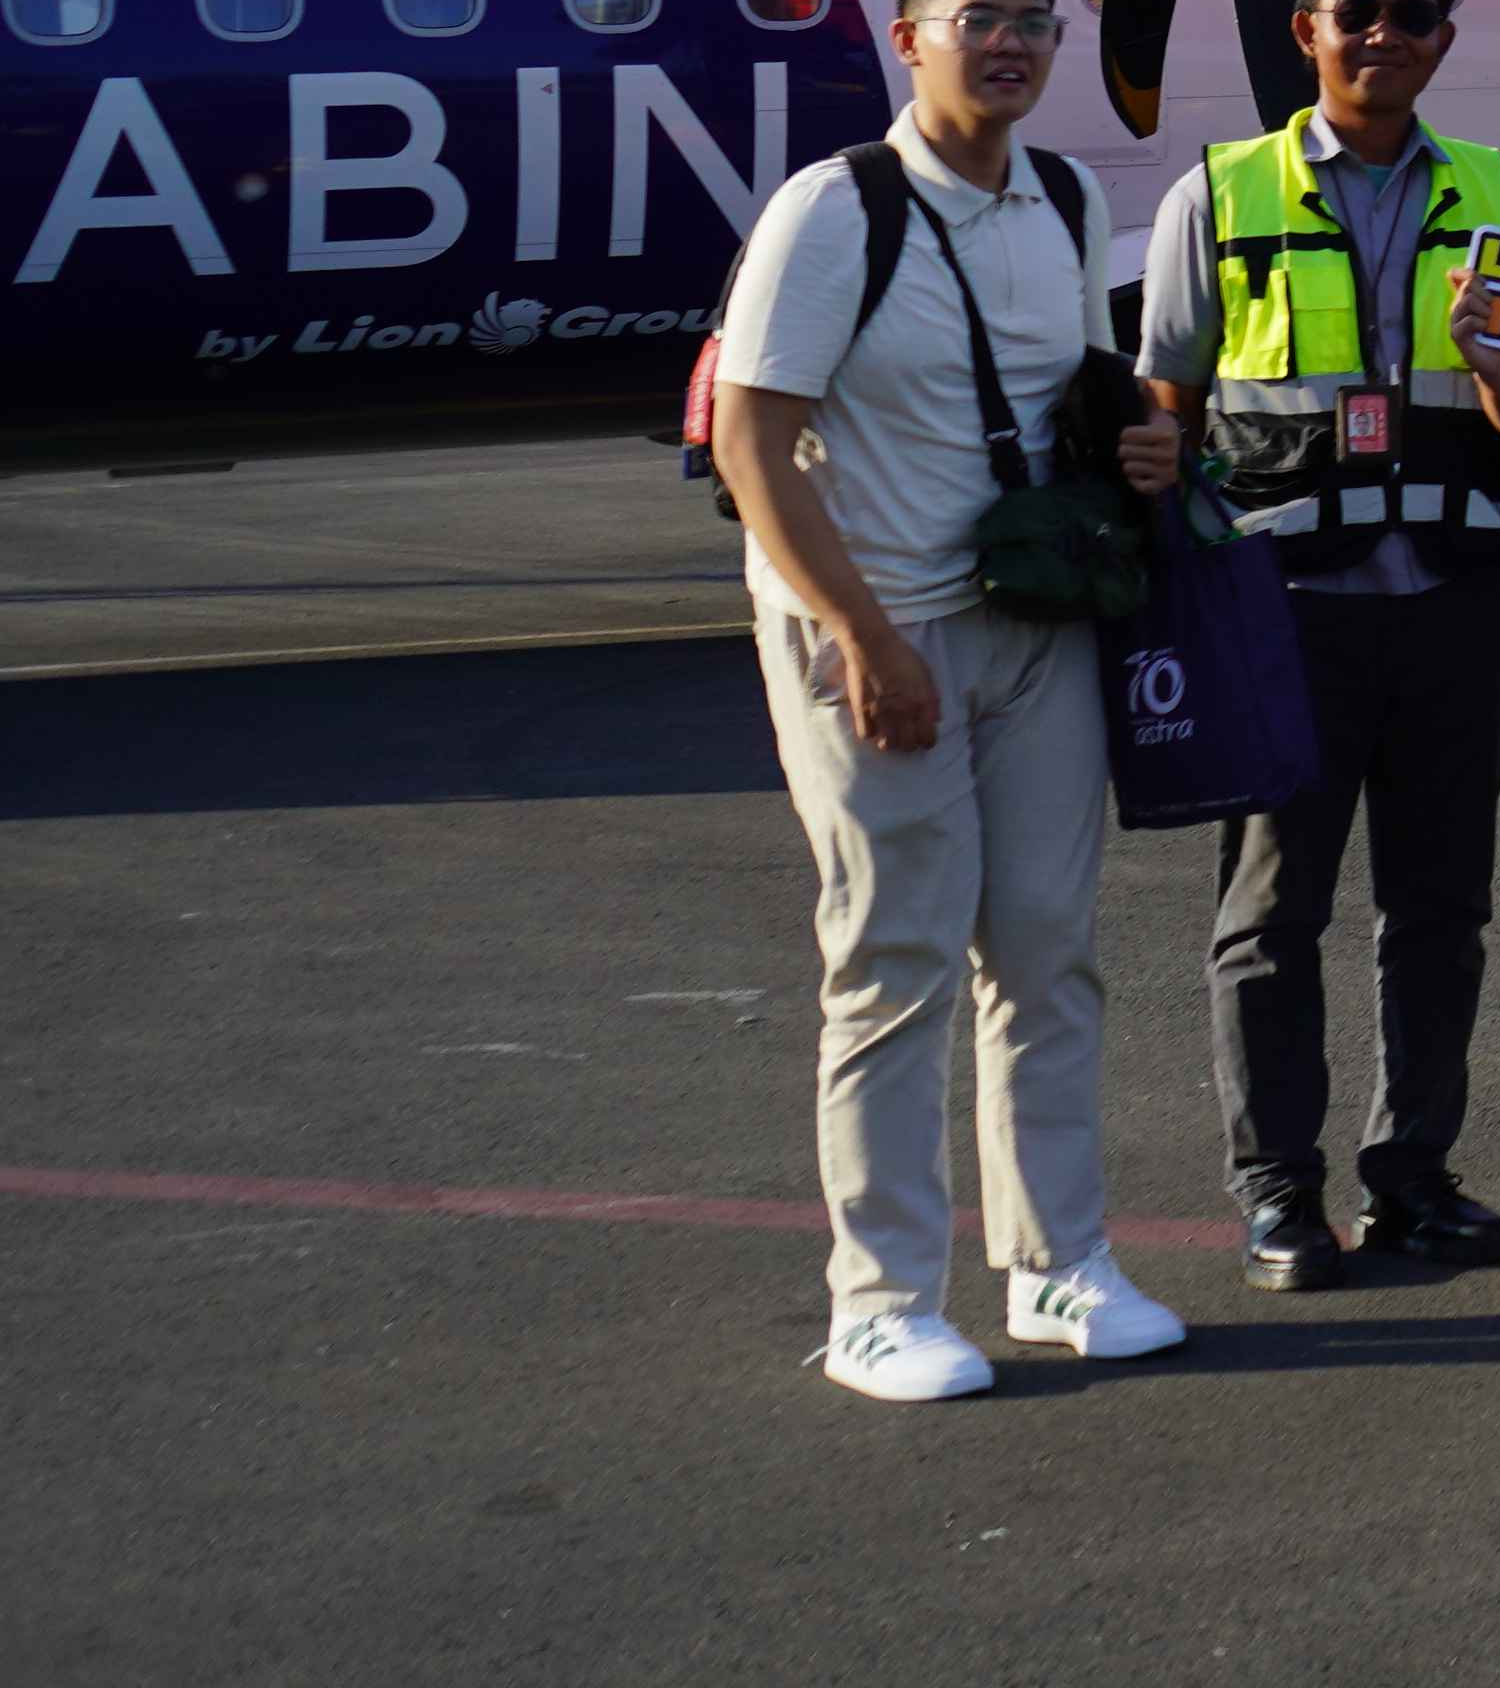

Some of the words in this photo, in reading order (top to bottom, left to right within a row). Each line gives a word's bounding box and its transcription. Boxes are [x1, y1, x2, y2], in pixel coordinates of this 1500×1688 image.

[13, 61, 788, 283] ABIN
[194, 329, 280, 363] by
[292, 315, 457, 354] Lion
[548, 305, 724, 339] Grou
